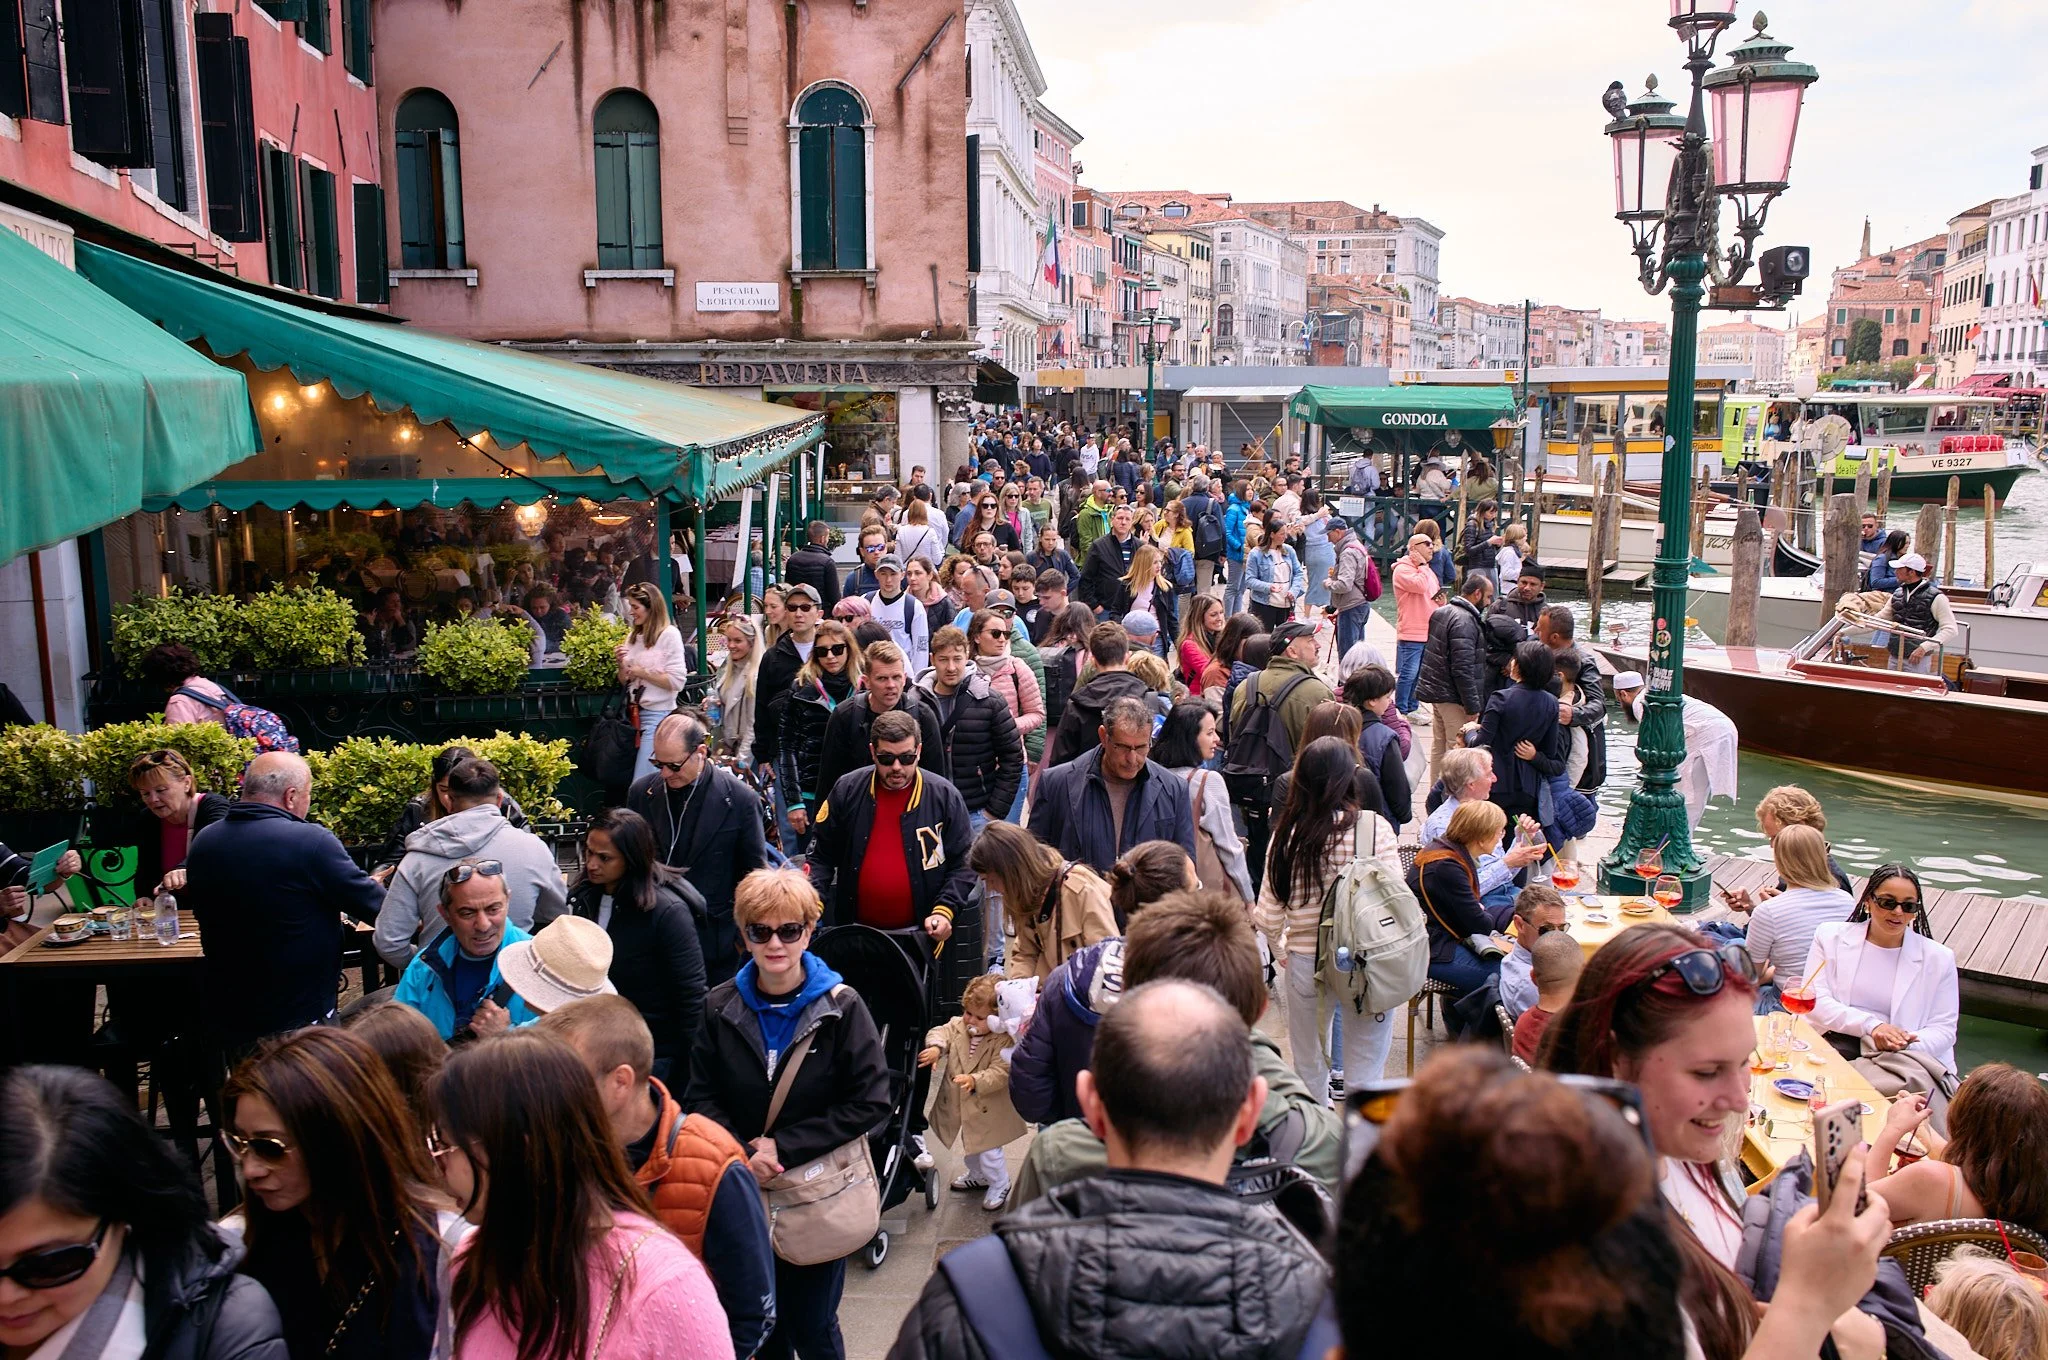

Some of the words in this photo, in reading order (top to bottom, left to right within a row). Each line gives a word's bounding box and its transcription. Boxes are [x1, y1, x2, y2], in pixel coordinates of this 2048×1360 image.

[701, 363, 870, 385] PEDAVENA
[1381, 412, 1448, 426] GONDOLA
[1692, 442, 1713, 450] Rialto
[1932, 459, 1944, 468] VE
[1946, 458, 1973, 468] 9327
